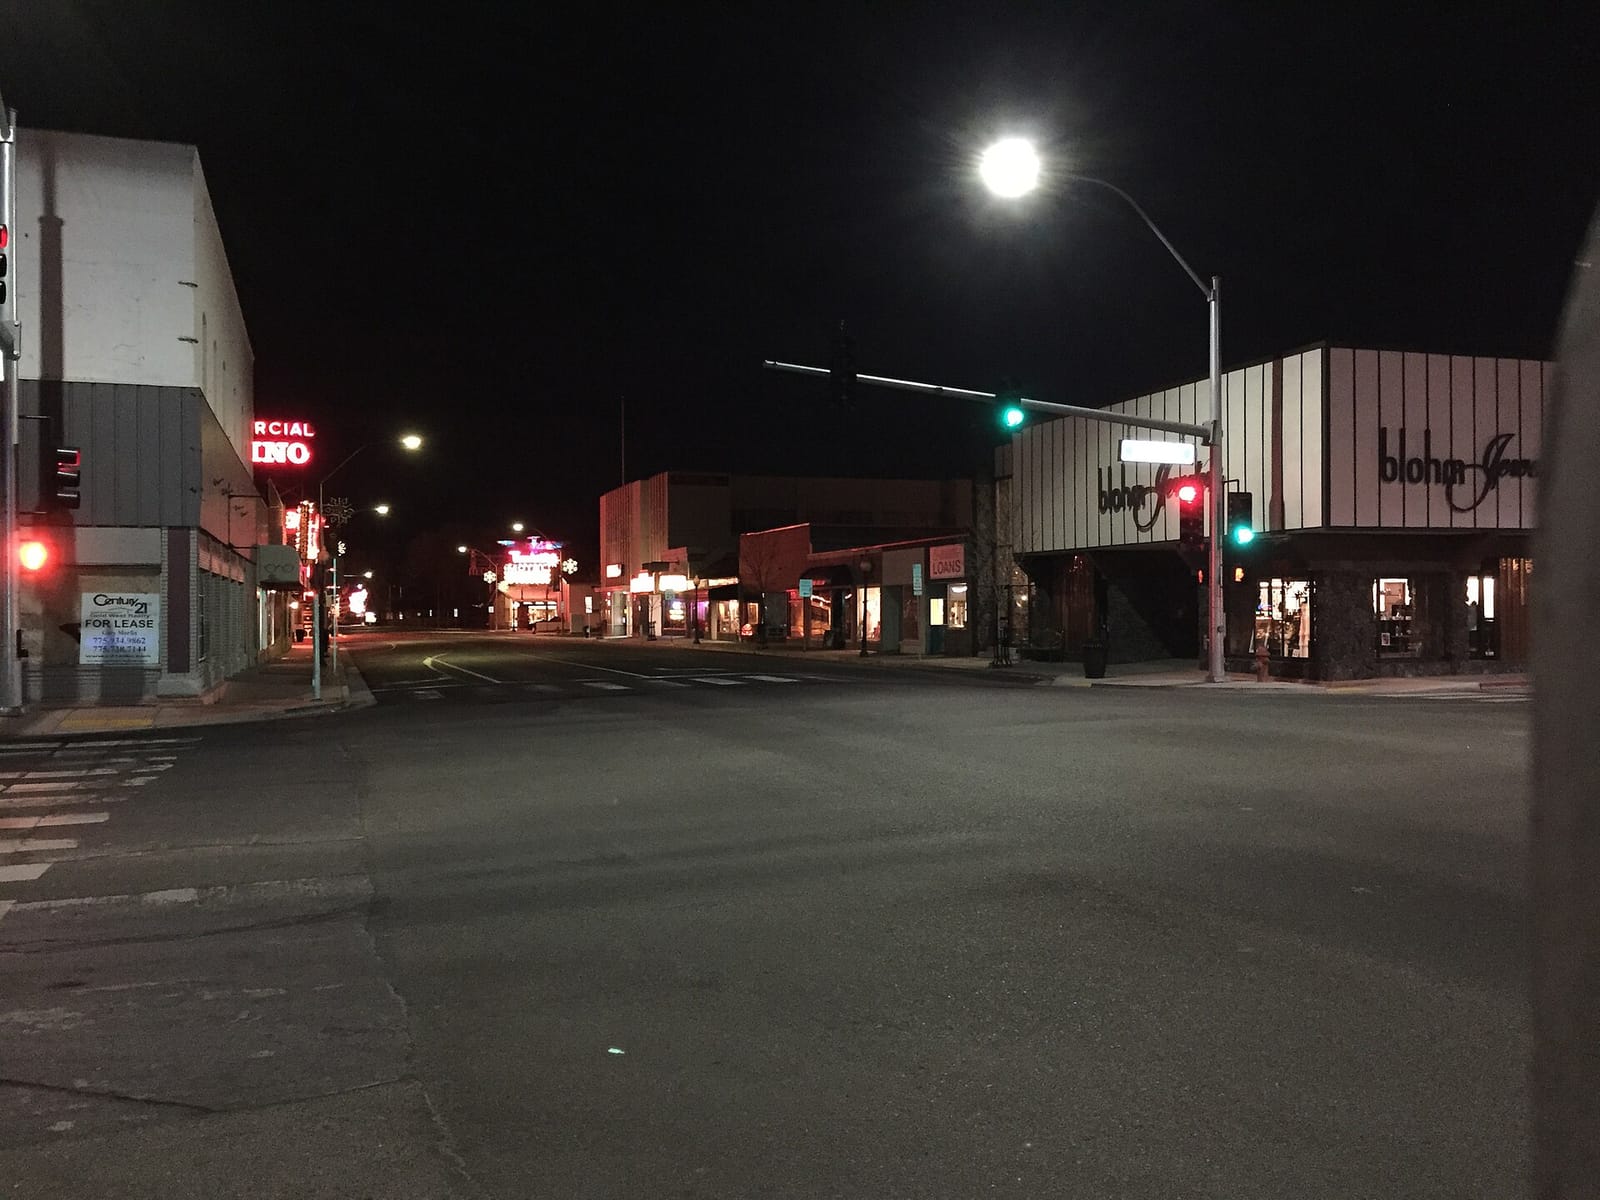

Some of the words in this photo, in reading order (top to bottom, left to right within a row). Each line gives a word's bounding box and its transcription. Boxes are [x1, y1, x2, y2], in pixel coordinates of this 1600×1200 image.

[1380, 427, 1466, 485] blohm
[1098, 463, 1147, 515] blohm
[933, 560, 961, 575] LOANS
[93, 594, 139, 607] Century
[134, 602, 148, 614] 21
[85, 619, 111, 628] FOR
[114, 619, 154, 628] LEASE
